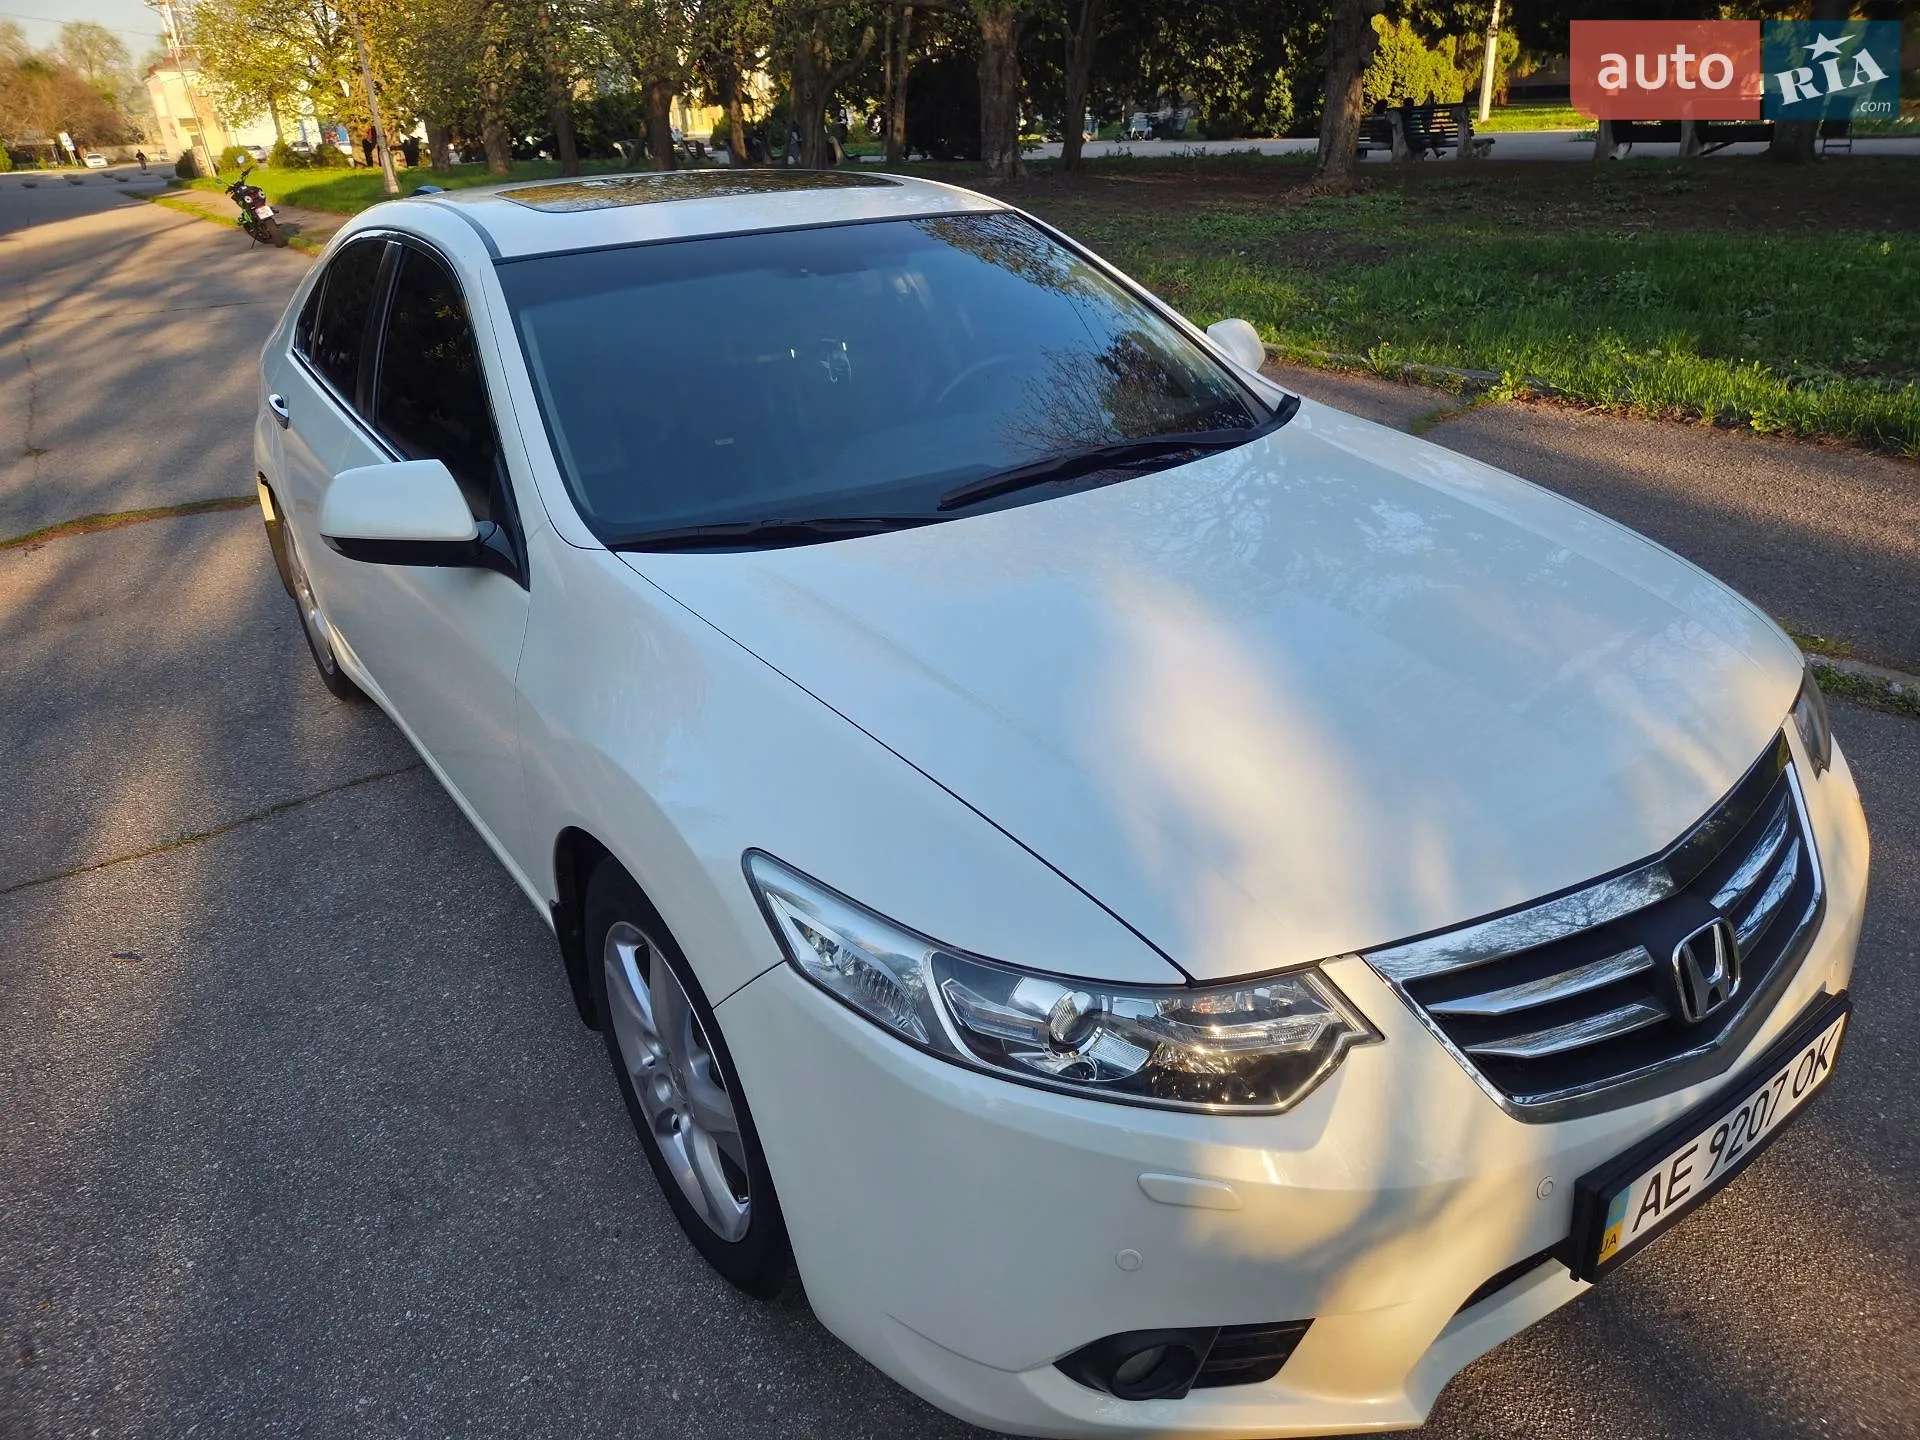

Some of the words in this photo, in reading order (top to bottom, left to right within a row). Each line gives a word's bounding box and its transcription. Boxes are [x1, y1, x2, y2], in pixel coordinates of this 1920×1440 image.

[1631, 1143, 1699, 1233] AE
[1704, 1070, 1789, 1180] 9207
[1792, 1022, 1841, 1100] OK
